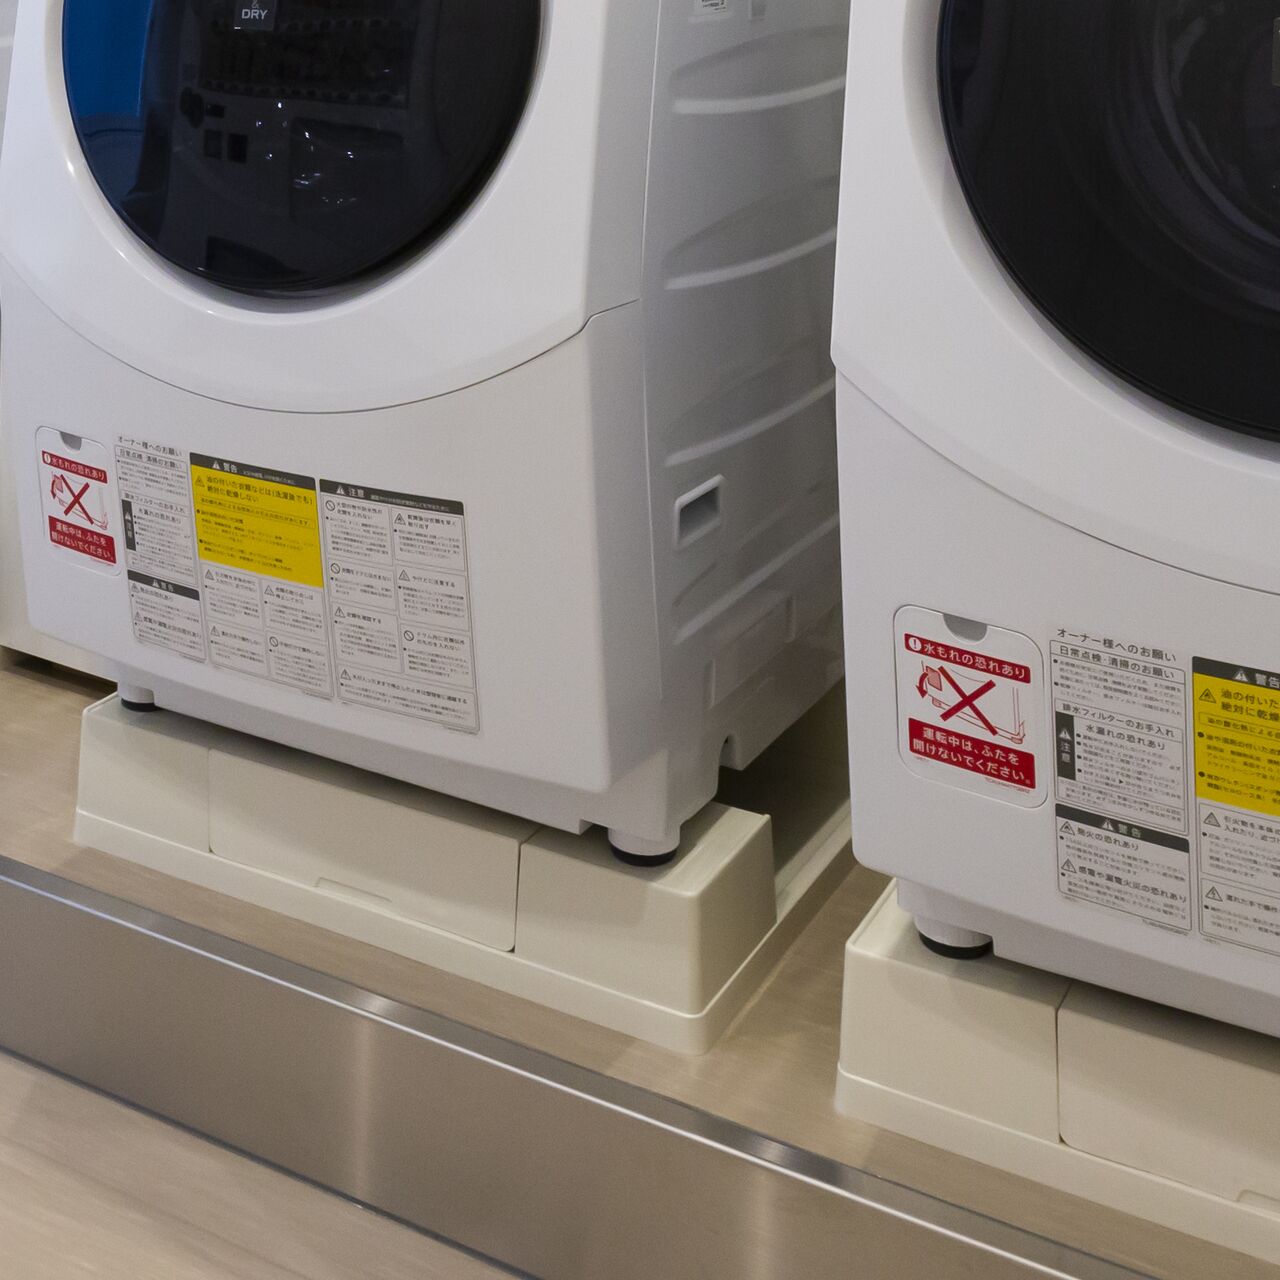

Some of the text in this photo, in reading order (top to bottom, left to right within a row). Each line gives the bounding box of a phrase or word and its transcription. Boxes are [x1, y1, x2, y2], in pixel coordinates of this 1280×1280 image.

[241, 9, 268, 20] DRY
[118, 436, 183, 458] オーナー様へのお願い
[50, 457, 105, 481] 水もれの恐れあり
[51, 531, 114, 561] 開けないでください。
[56, 521, 107, 546] 運転中は、ふたを
[1057, 628, 1176, 662] オーナー様へのお願い
[923, 642, 1027, 680] 水もれの恐れあり
[1059, 645, 1174, 679] 日常点検・清掃のお願い
[1255, 673, 1280, 689] 警告
[1062, 703, 1175, 738] 排水フィルターのお手入れ
[922, 726, 1020, 765] 運転中は、ふたを
[1086, 724, 1165, 751] 水漏れの恐れあり
[913, 737, 1032, 785] 開けないでください。
